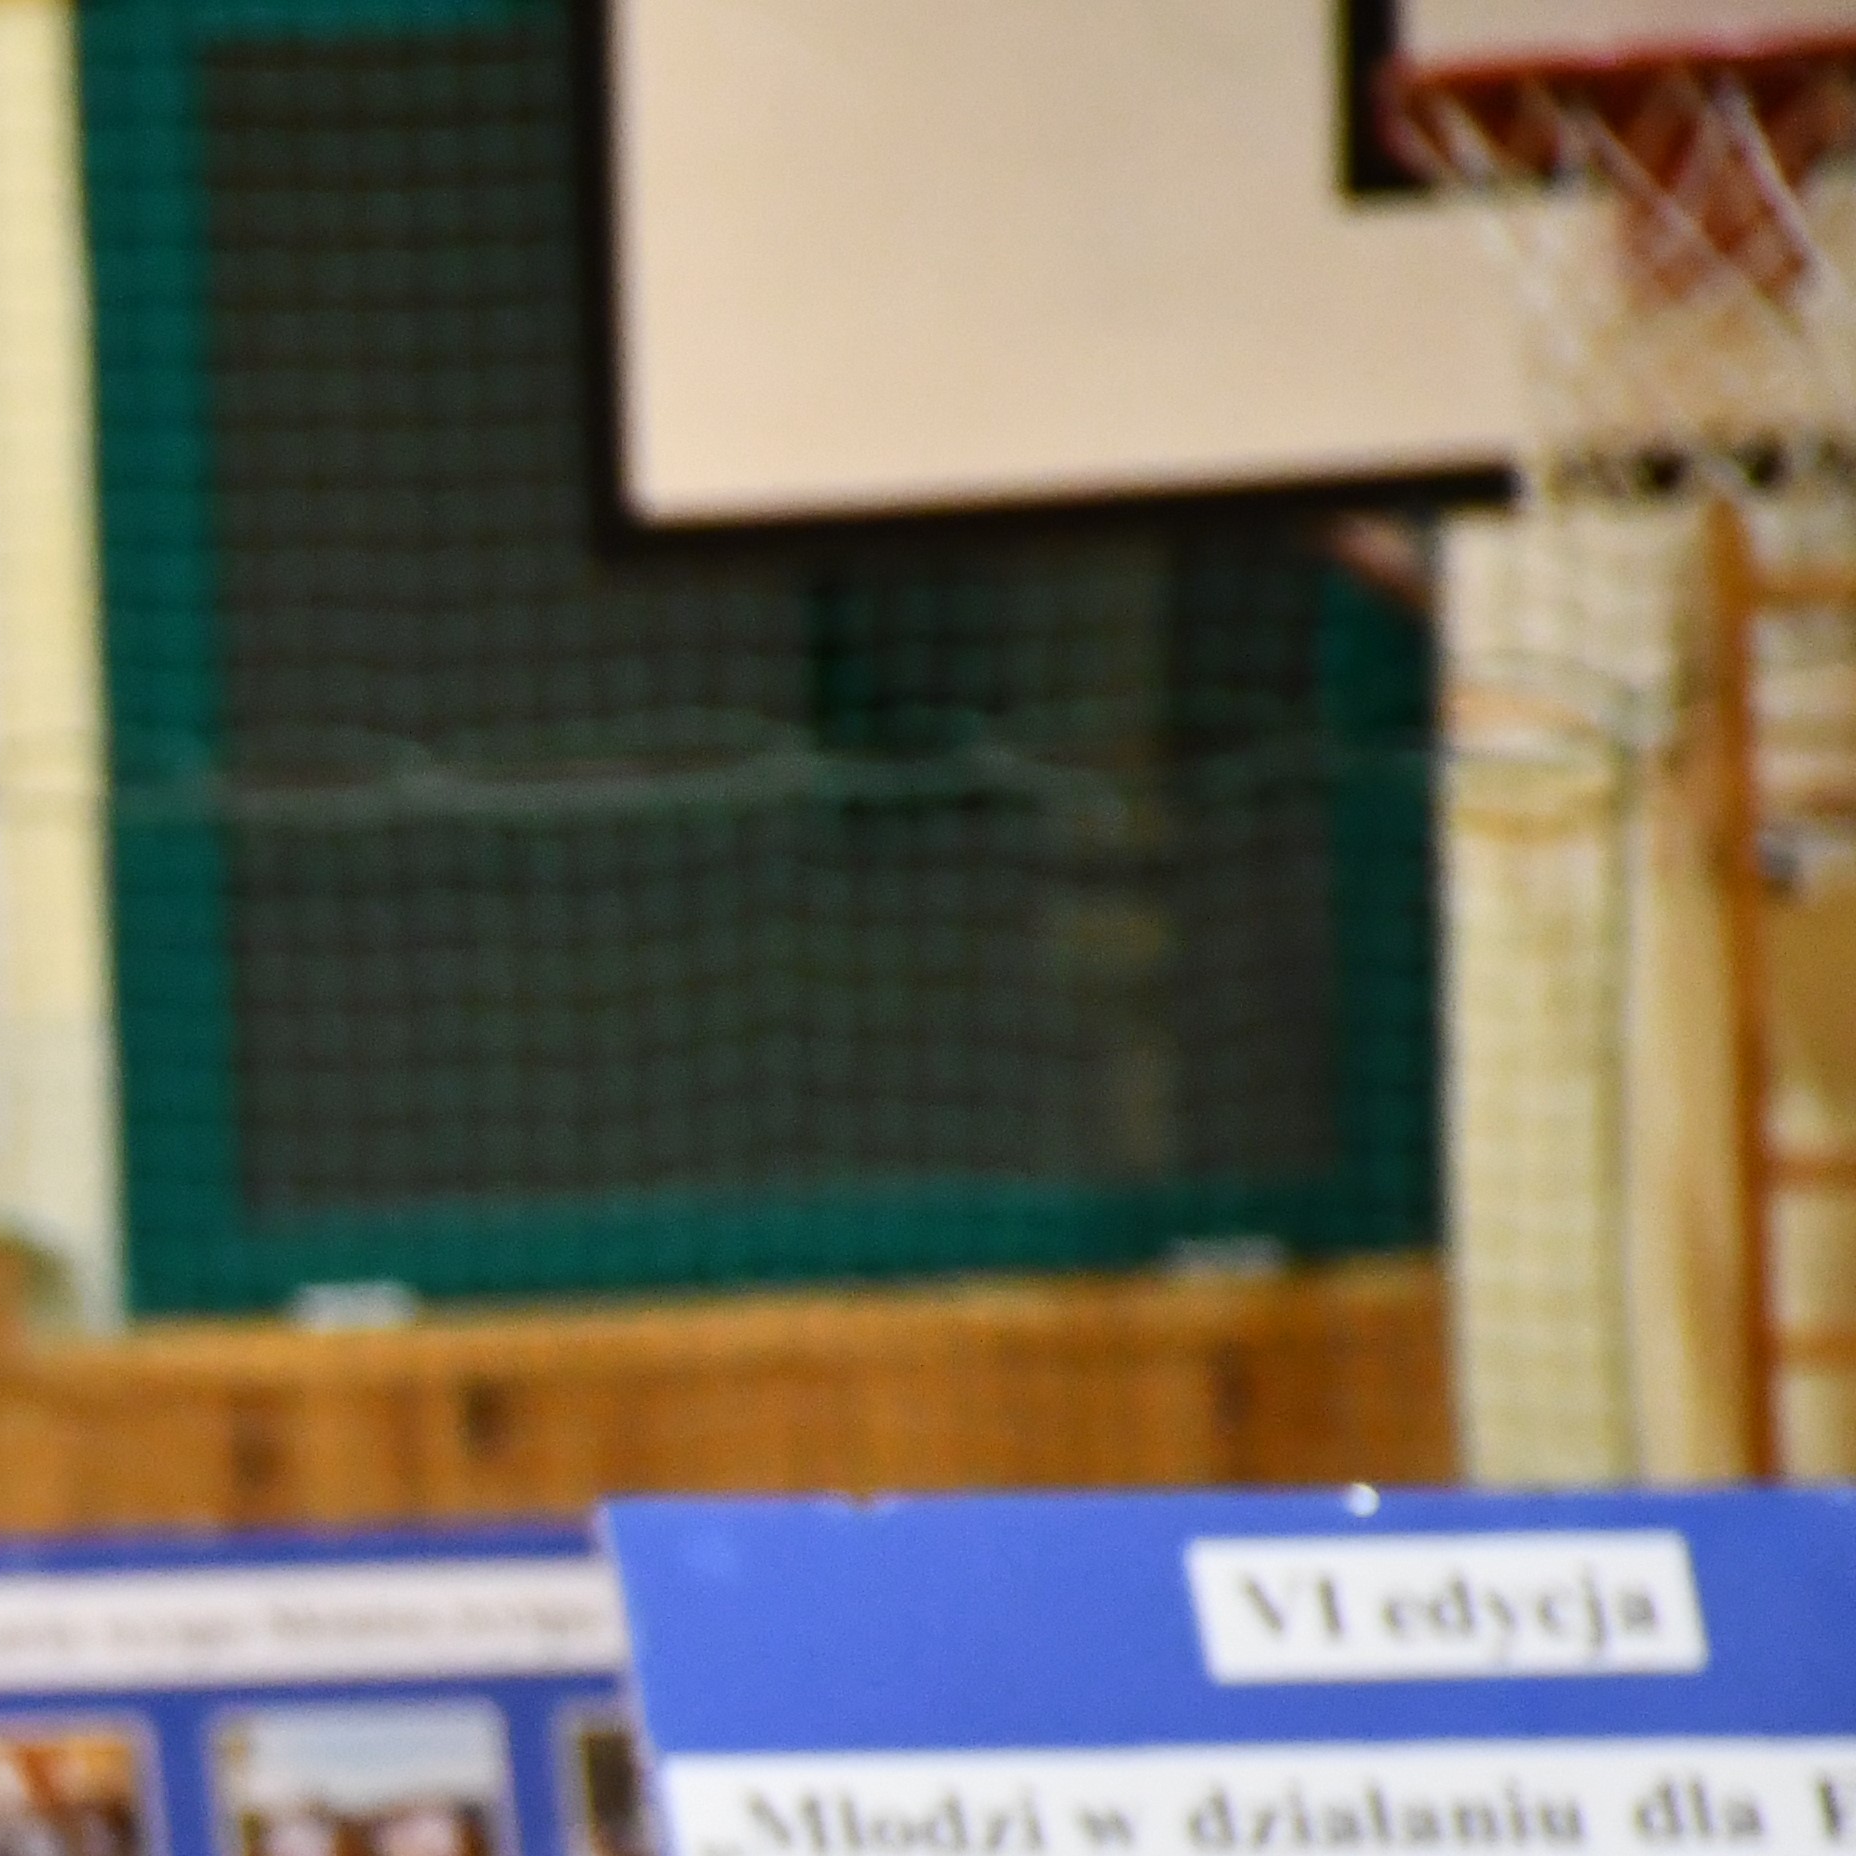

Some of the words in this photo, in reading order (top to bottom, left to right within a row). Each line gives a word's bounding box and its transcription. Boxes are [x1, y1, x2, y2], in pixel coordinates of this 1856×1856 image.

[1238, 1570, 1350, 1646] VI
[1372, 1562, 1662, 1668] edycja
[1074, 1800, 1144, 1848] w
[1630, 1772, 1772, 1846] dla
